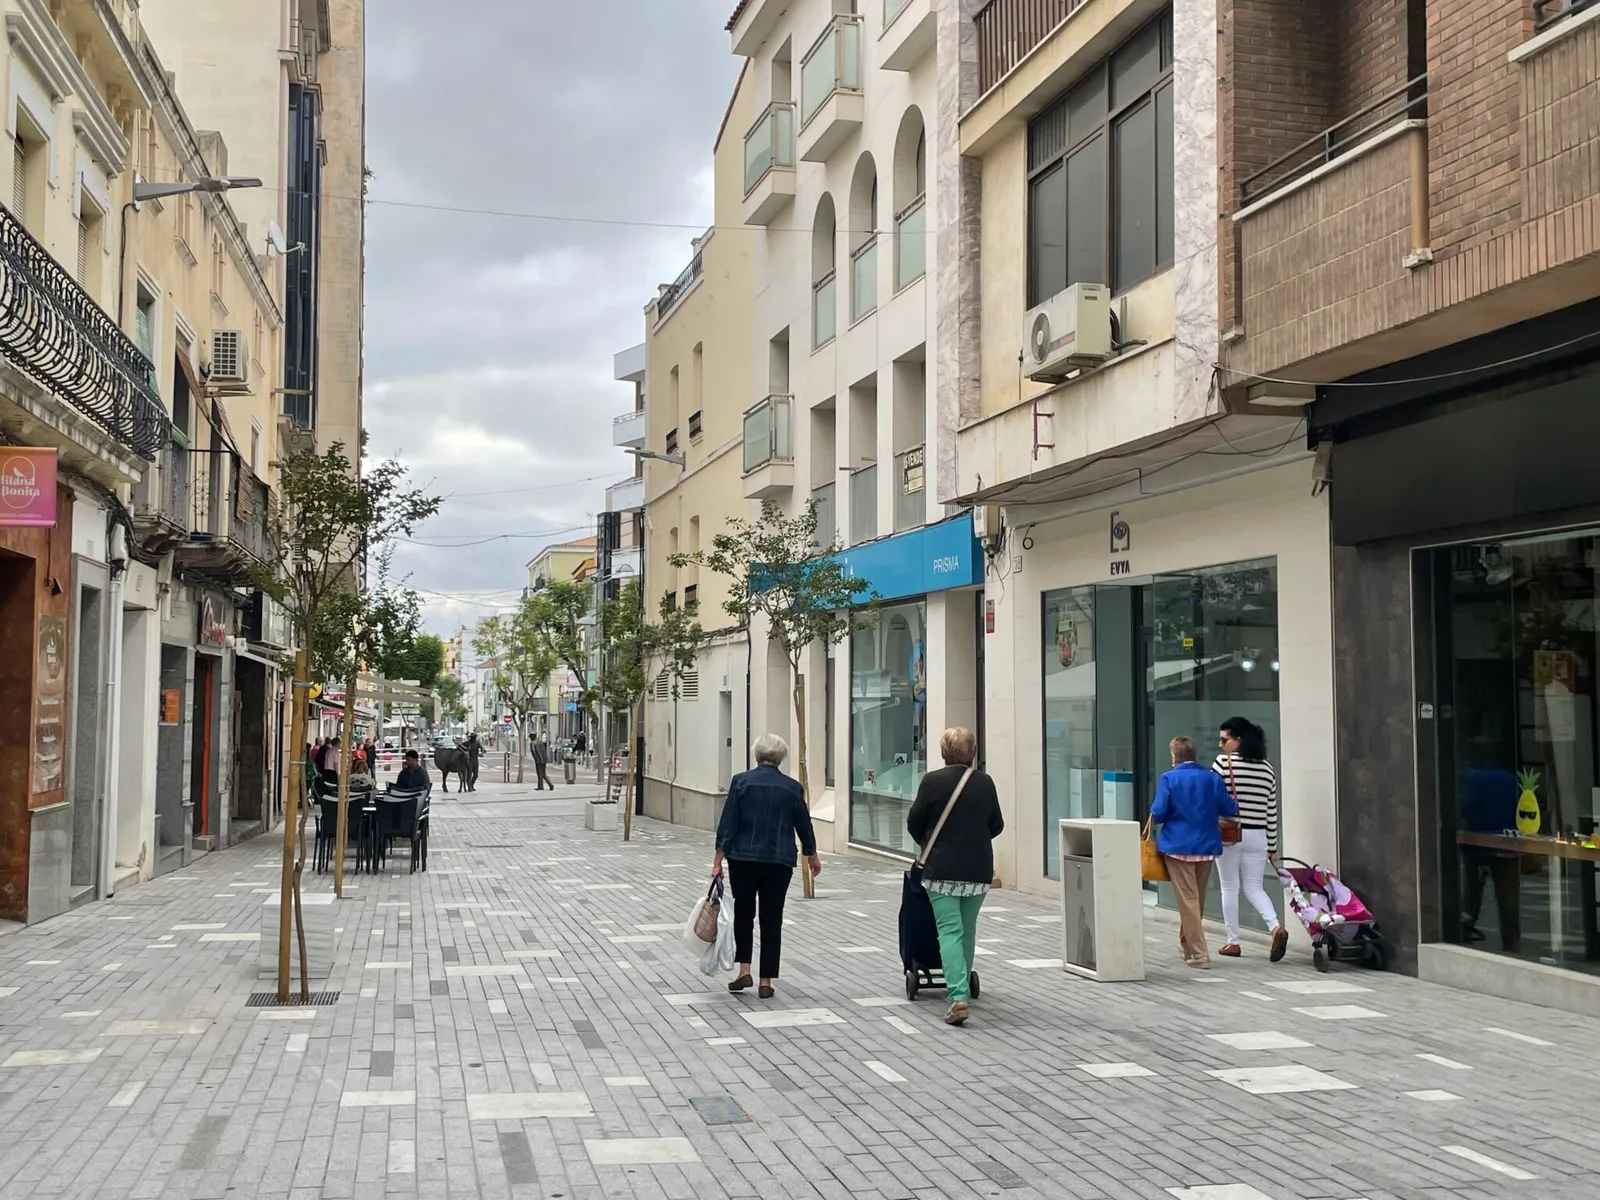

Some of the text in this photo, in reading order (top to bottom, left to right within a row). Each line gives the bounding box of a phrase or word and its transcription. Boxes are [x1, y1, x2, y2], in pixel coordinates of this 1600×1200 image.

[2, 485, 40, 497] Bonita
[933, 555, 960, 574] PRISMA
[1110, 560, 1130, 576] EVYA
